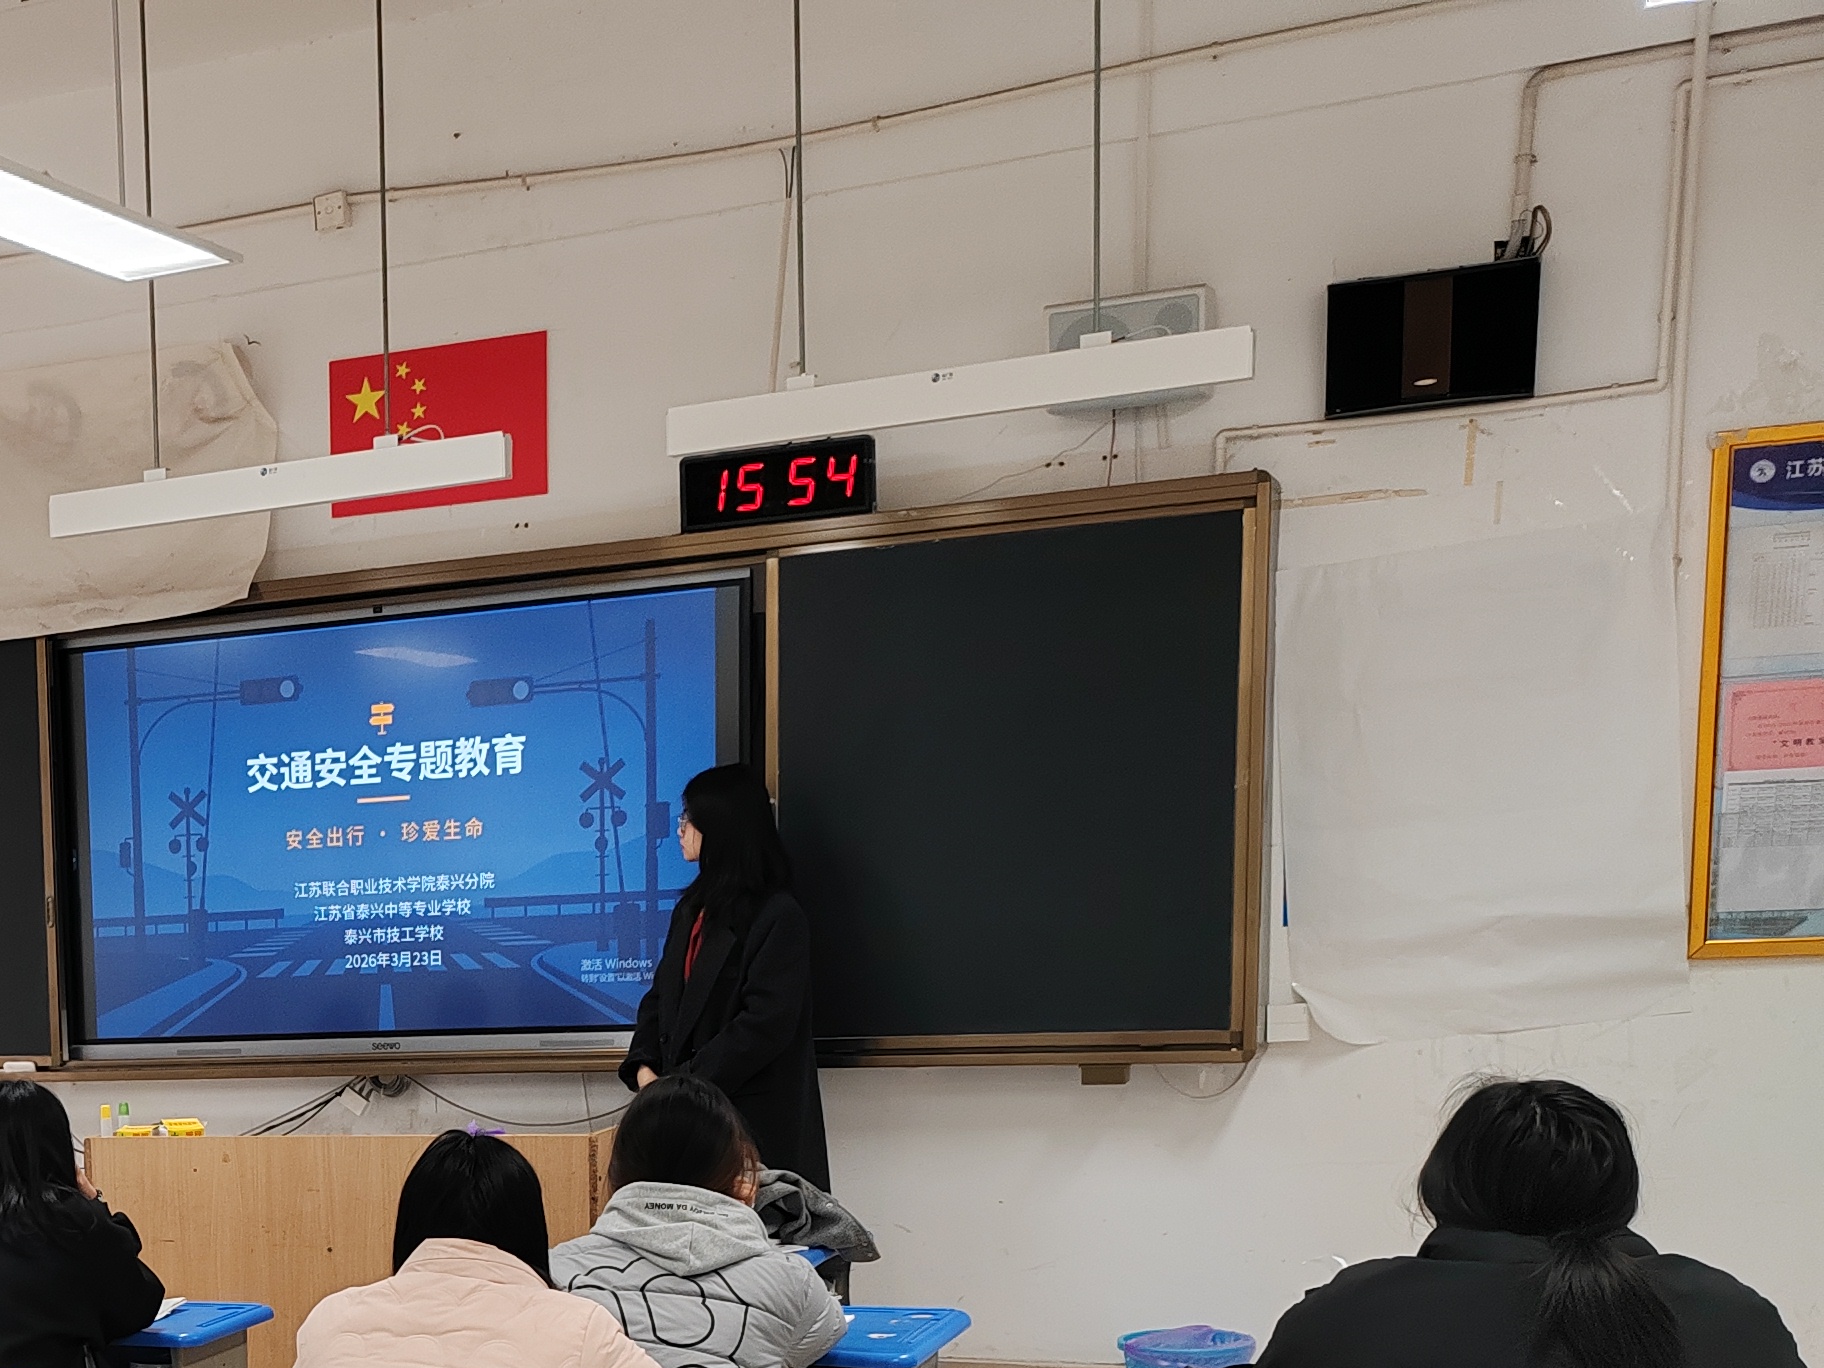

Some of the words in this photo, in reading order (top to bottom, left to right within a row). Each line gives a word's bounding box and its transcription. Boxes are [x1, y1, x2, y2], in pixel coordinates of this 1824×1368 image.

[716, 462, 765, 513] 15
[786, 453, 858, 508] 54
[245, 732, 527, 794] 交通安全专题教育
[285, 824, 365, 850] 安全出行
[400, 816, 484, 843] 珍爱生命
[293, 871, 496, 899] 江苏联合职业技术学院泰兴分院
[313, 897, 472, 922] 江苏省泰兴中等专业学校
[343, 923, 445, 945] 泰兴市技工学校
[344, 949, 443, 969] 2026年3月23日
[604, 957, 653, 970] Windows
